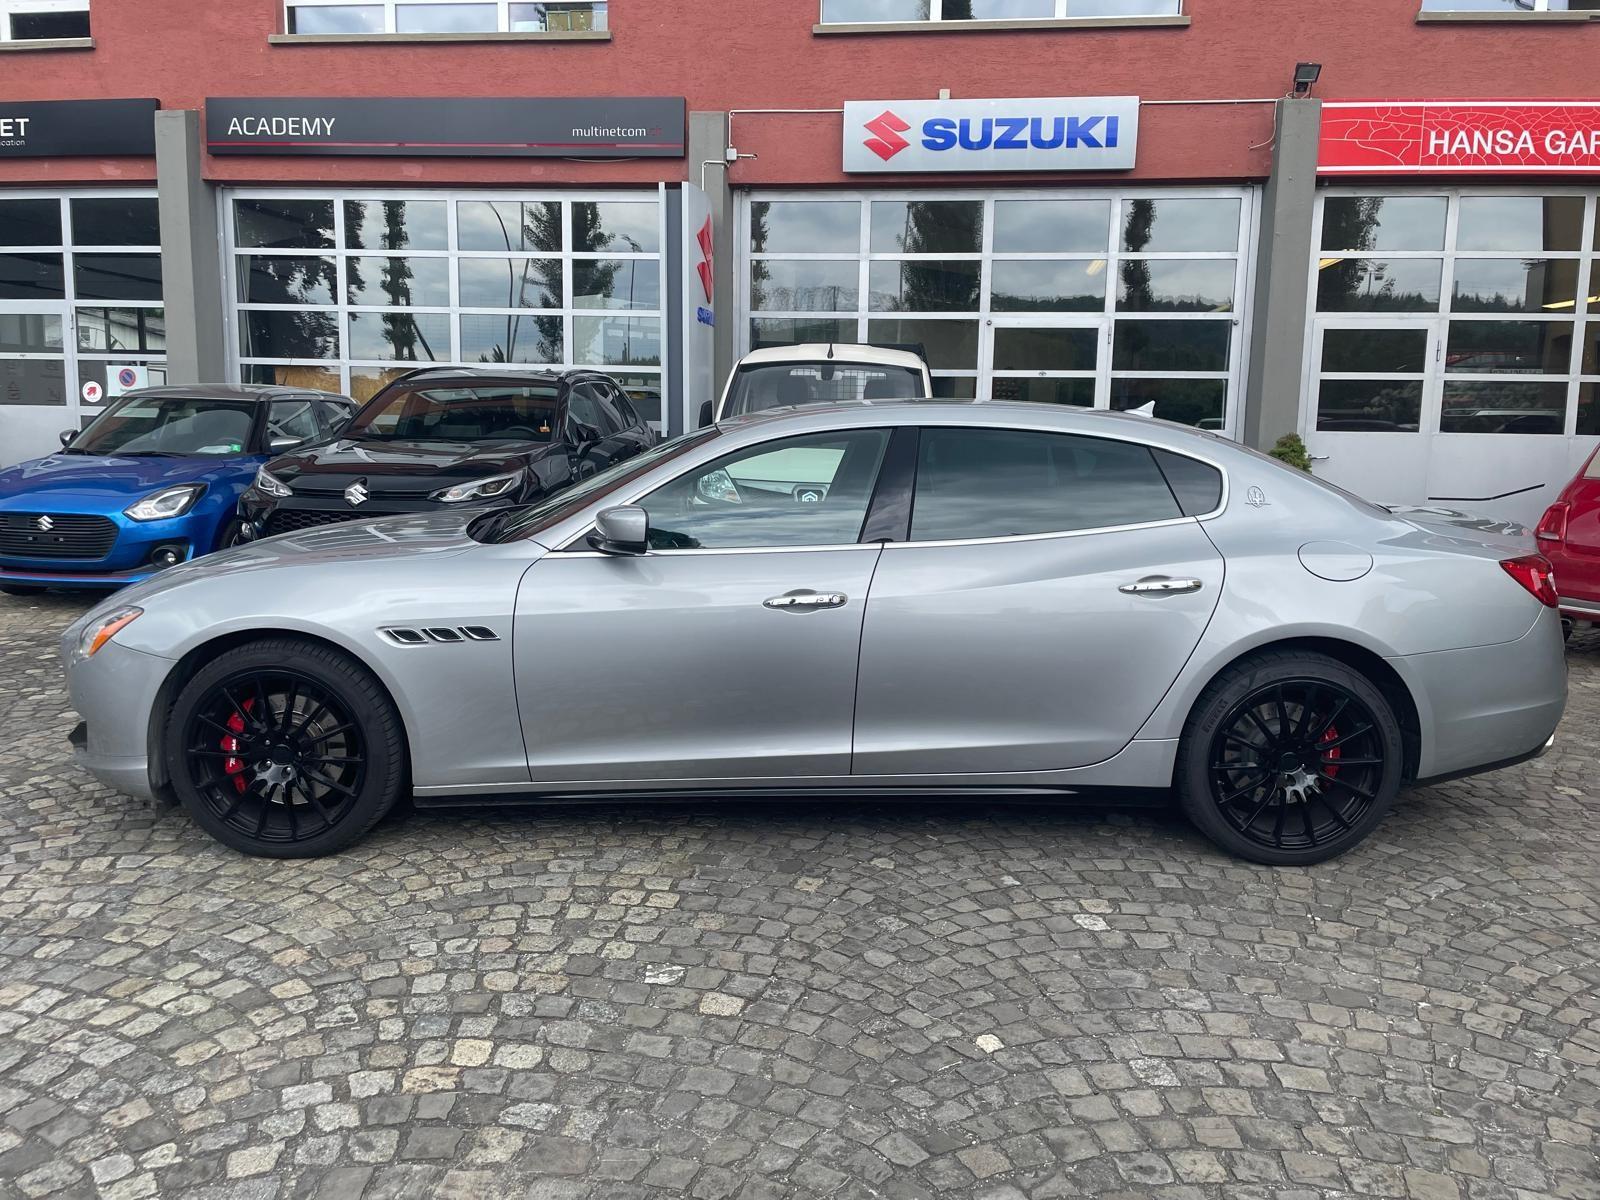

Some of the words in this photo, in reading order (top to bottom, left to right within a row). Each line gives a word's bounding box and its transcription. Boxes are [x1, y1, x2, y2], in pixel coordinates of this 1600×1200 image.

[227, 117, 336, 136] ACADEMY
[921, 115, 1119, 151] SUZUKI
[1428, 130, 1536, 155] HANSA
